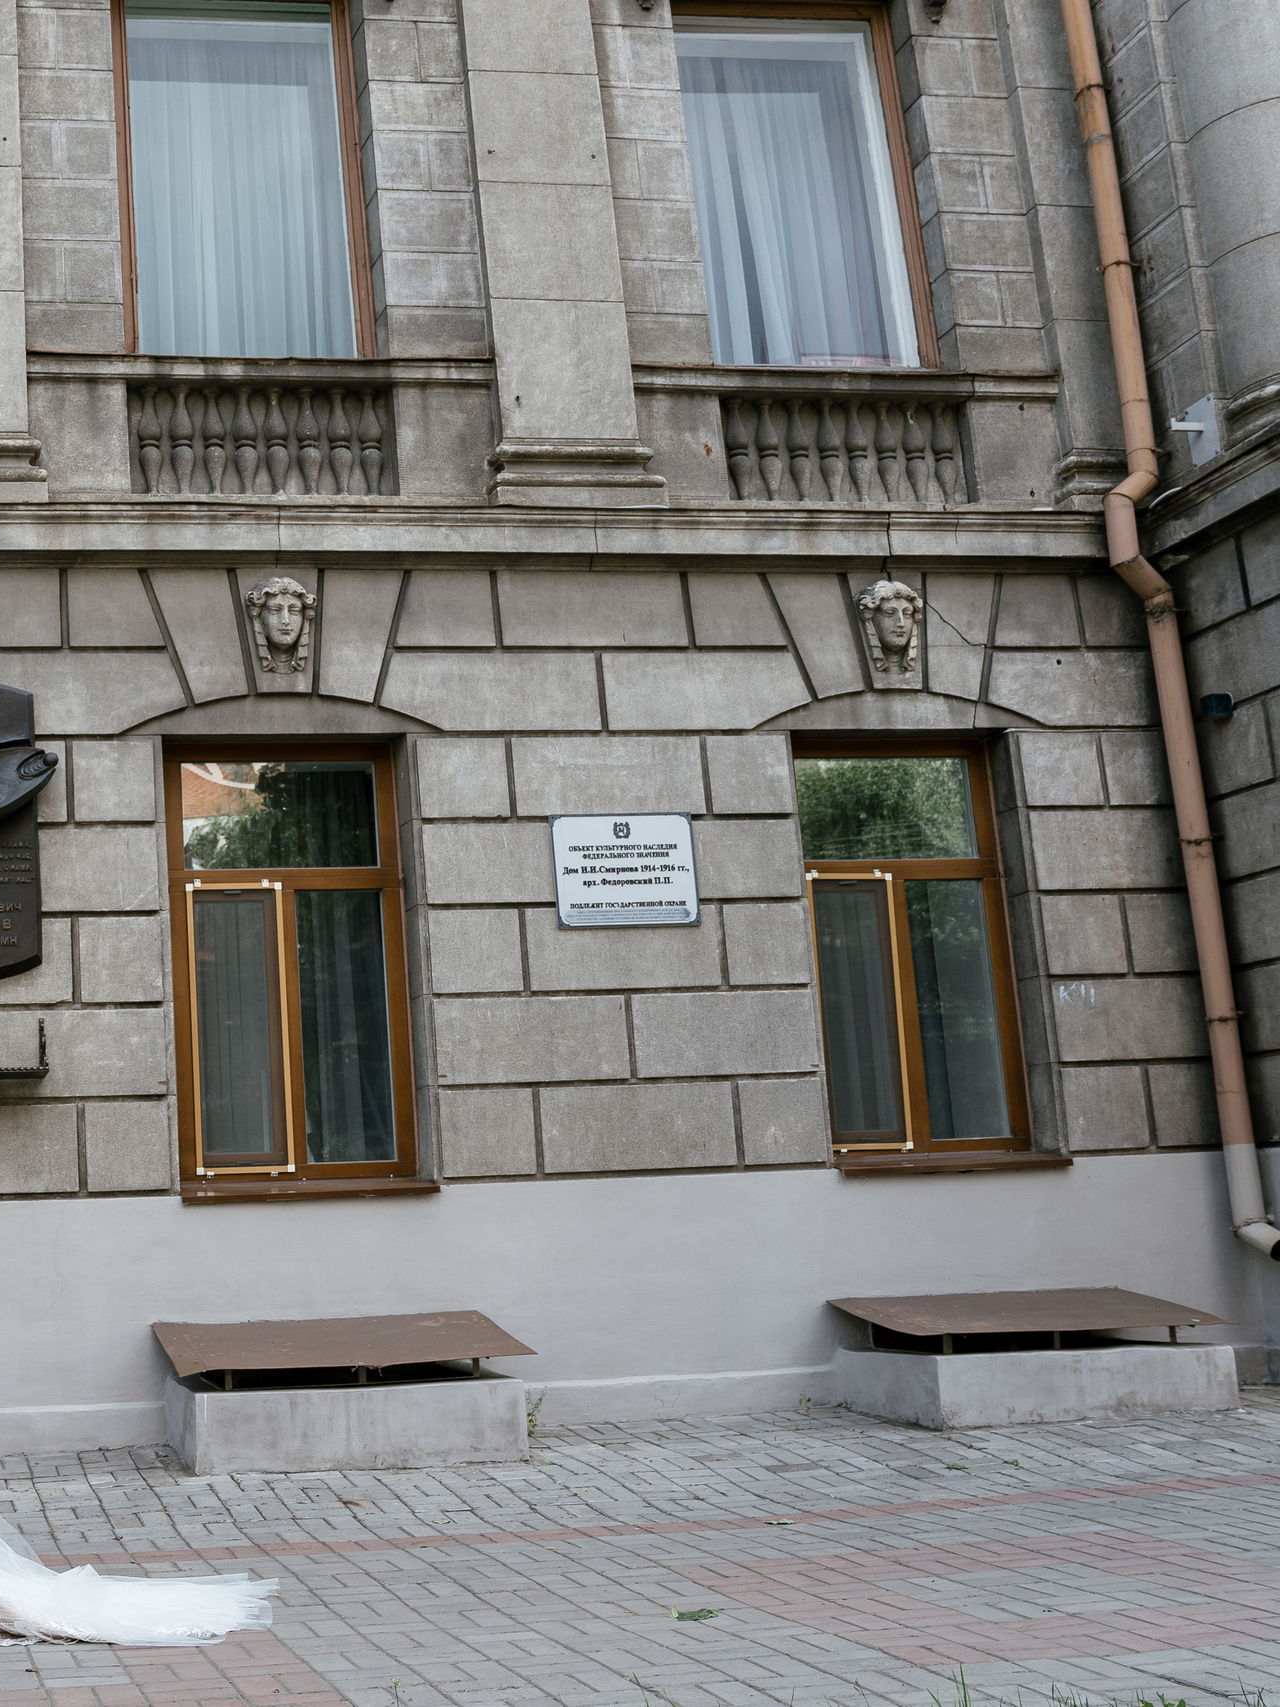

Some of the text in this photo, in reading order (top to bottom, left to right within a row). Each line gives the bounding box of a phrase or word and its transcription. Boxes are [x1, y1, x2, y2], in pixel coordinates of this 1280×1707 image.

[563, 867, 578, 875] Дом
[640, 864, 676, 872] 1914-1916
[583, 880, 600, 888] арх.
[600, 877, 653, 887] Федоровский
